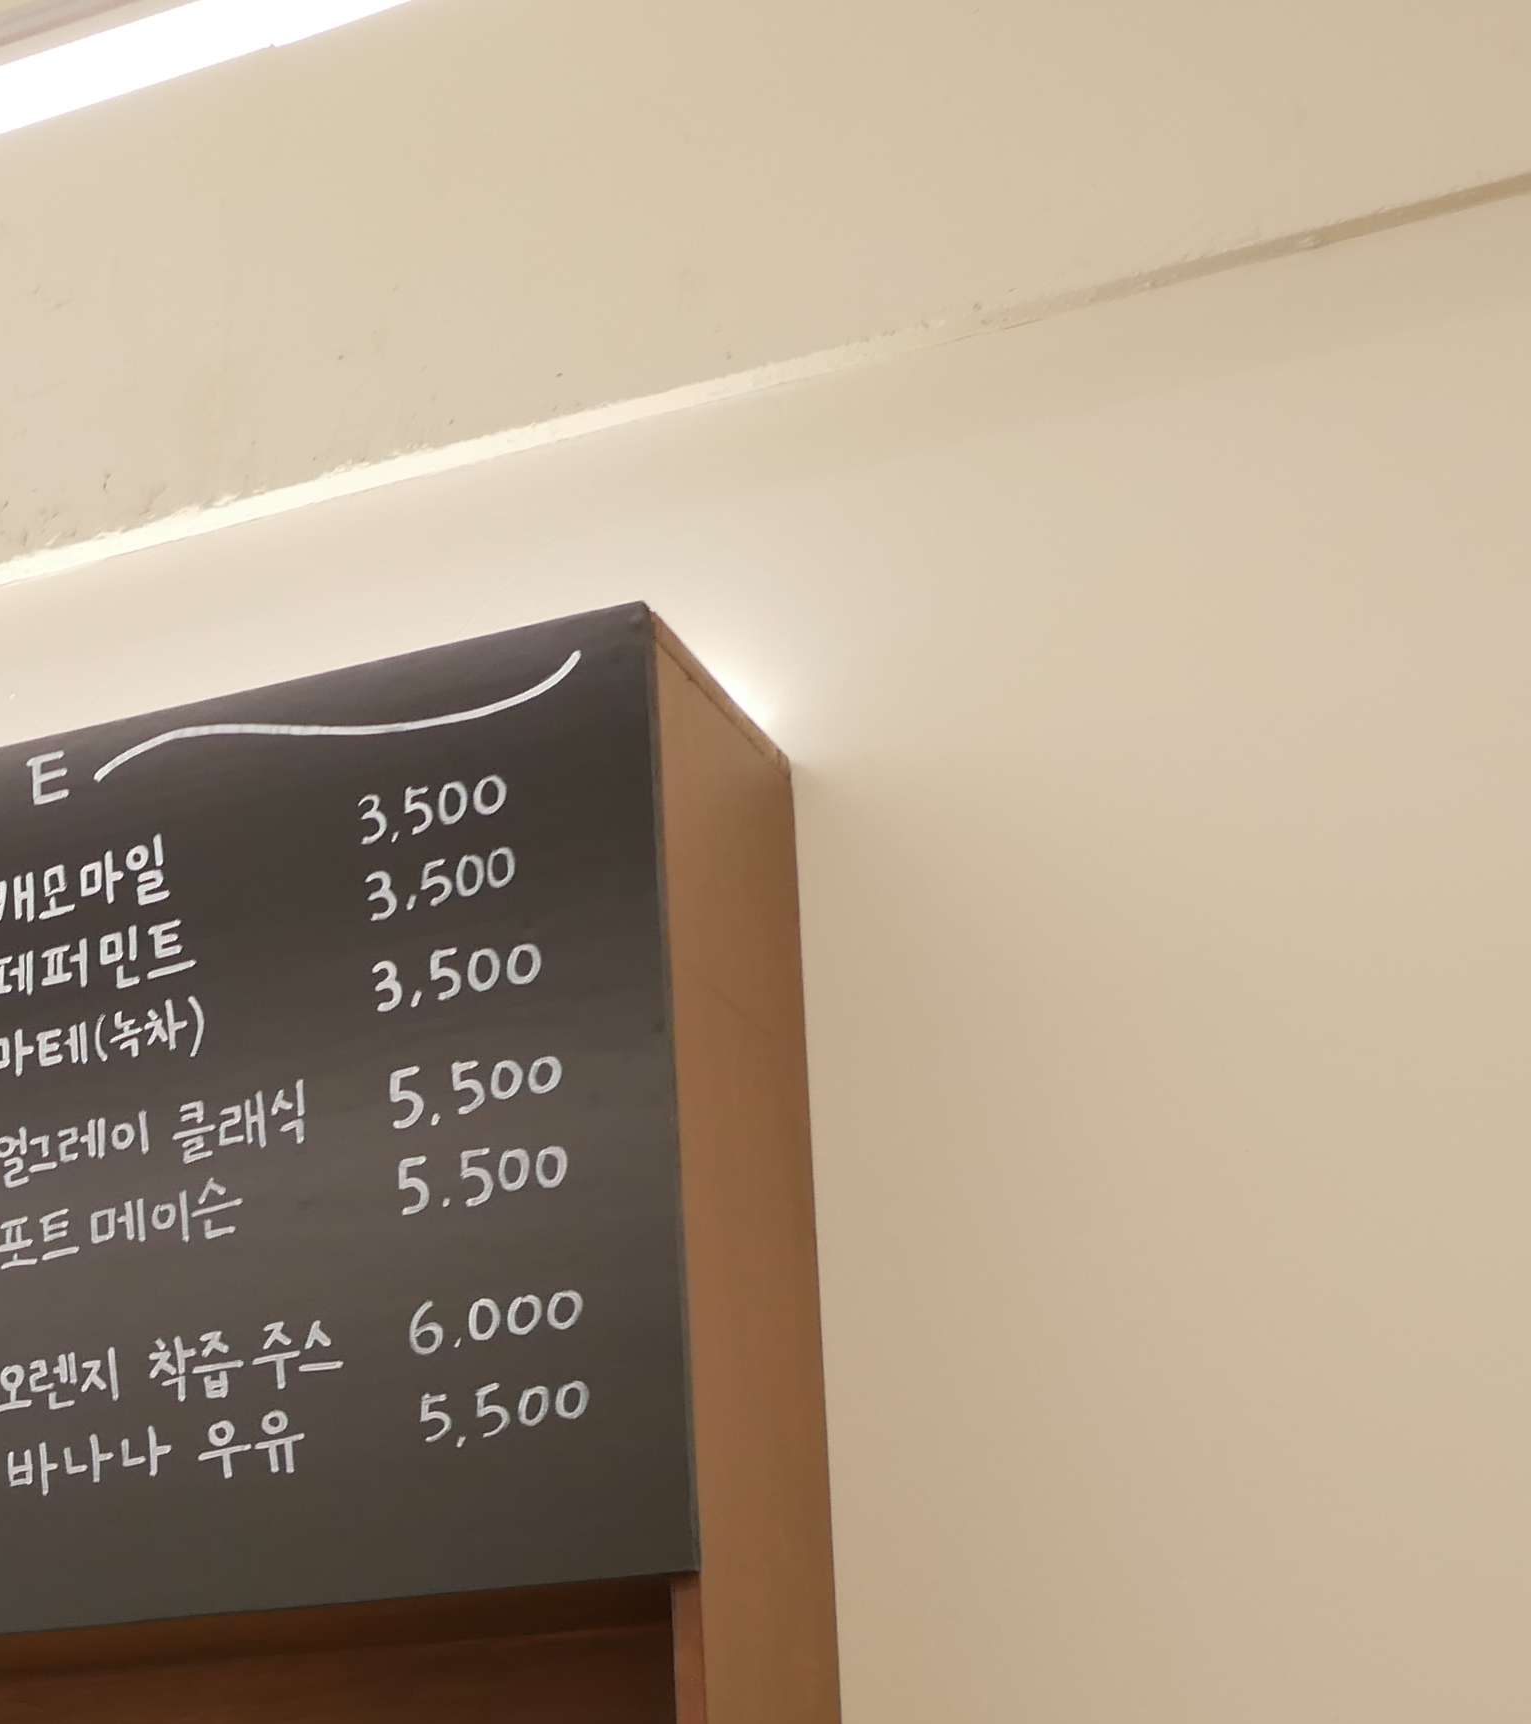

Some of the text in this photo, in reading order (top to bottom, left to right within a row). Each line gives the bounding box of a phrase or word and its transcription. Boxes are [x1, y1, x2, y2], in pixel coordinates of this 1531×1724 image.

[358, 775, 507, 844] 3,500
[372, 944, 541, 1012] 3,500
[172, 1079, 305, 1164] 클래식
[8, 1381, 589, 1496] 바나나 우유 5,500
